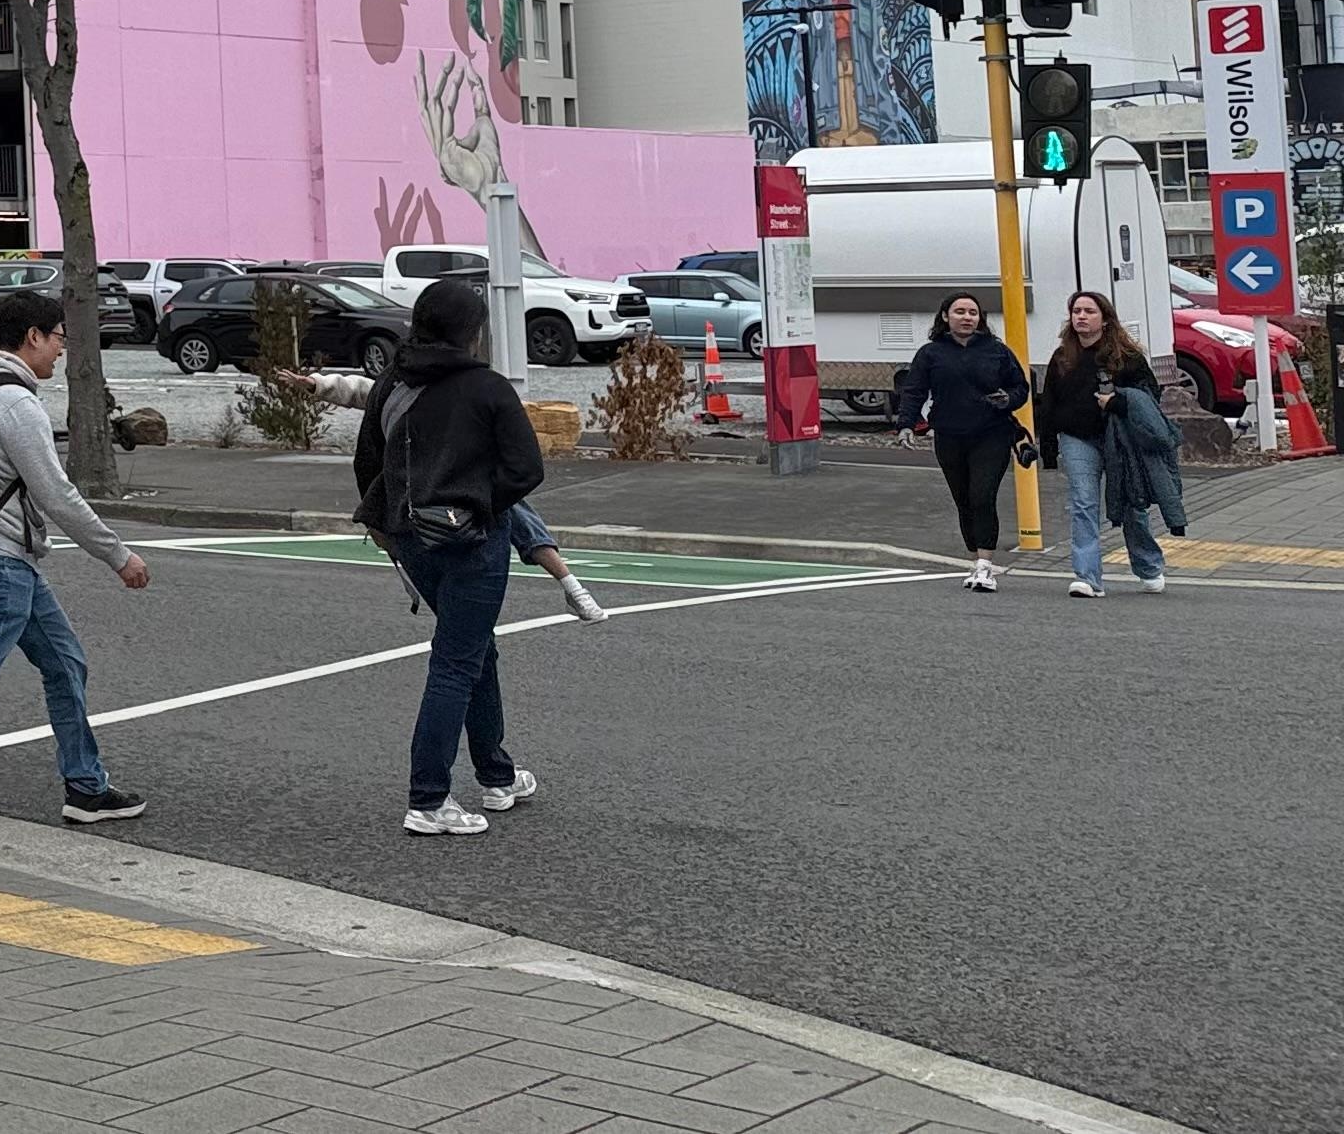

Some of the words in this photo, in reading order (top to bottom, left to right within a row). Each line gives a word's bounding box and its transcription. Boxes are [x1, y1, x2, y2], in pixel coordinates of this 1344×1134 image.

[1226, 59, 1254, 154] Wilson
[770, 218, 788, 230] Street
[1235, 198, 1265, 229] P
